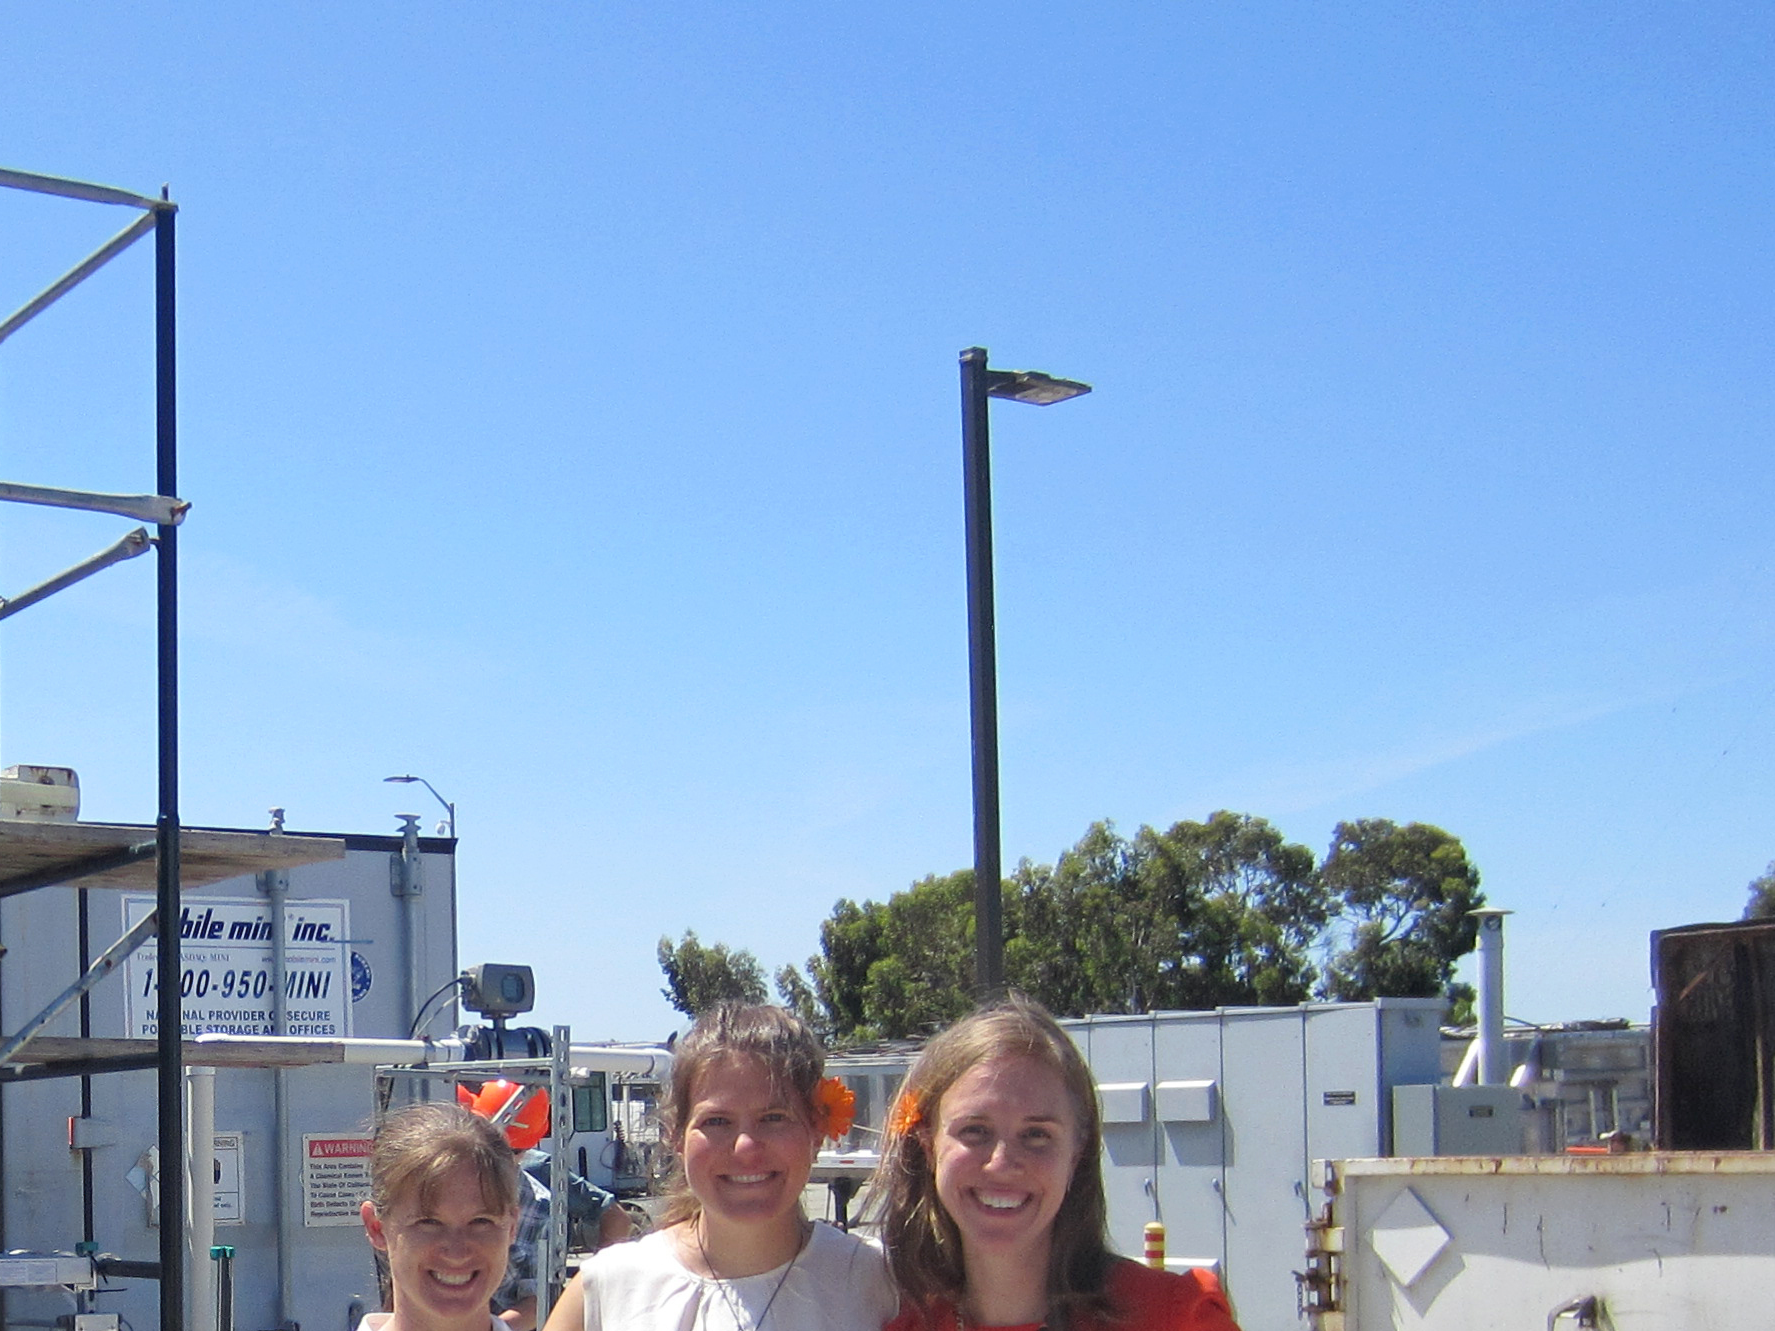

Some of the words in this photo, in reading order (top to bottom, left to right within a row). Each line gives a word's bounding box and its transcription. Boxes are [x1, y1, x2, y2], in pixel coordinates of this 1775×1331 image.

[153, 907, 225, 940] bile
[227, 916, 273, 941] min
[291, 917, 335, 942] inc.
[209, 1010, 265, 1021] PROVIDER
[286, 1010, 330, 1021] SECURE
[206, 1024, 260, 1036] STORAGE
[289, 1024, 336, 1035] OFFICES
